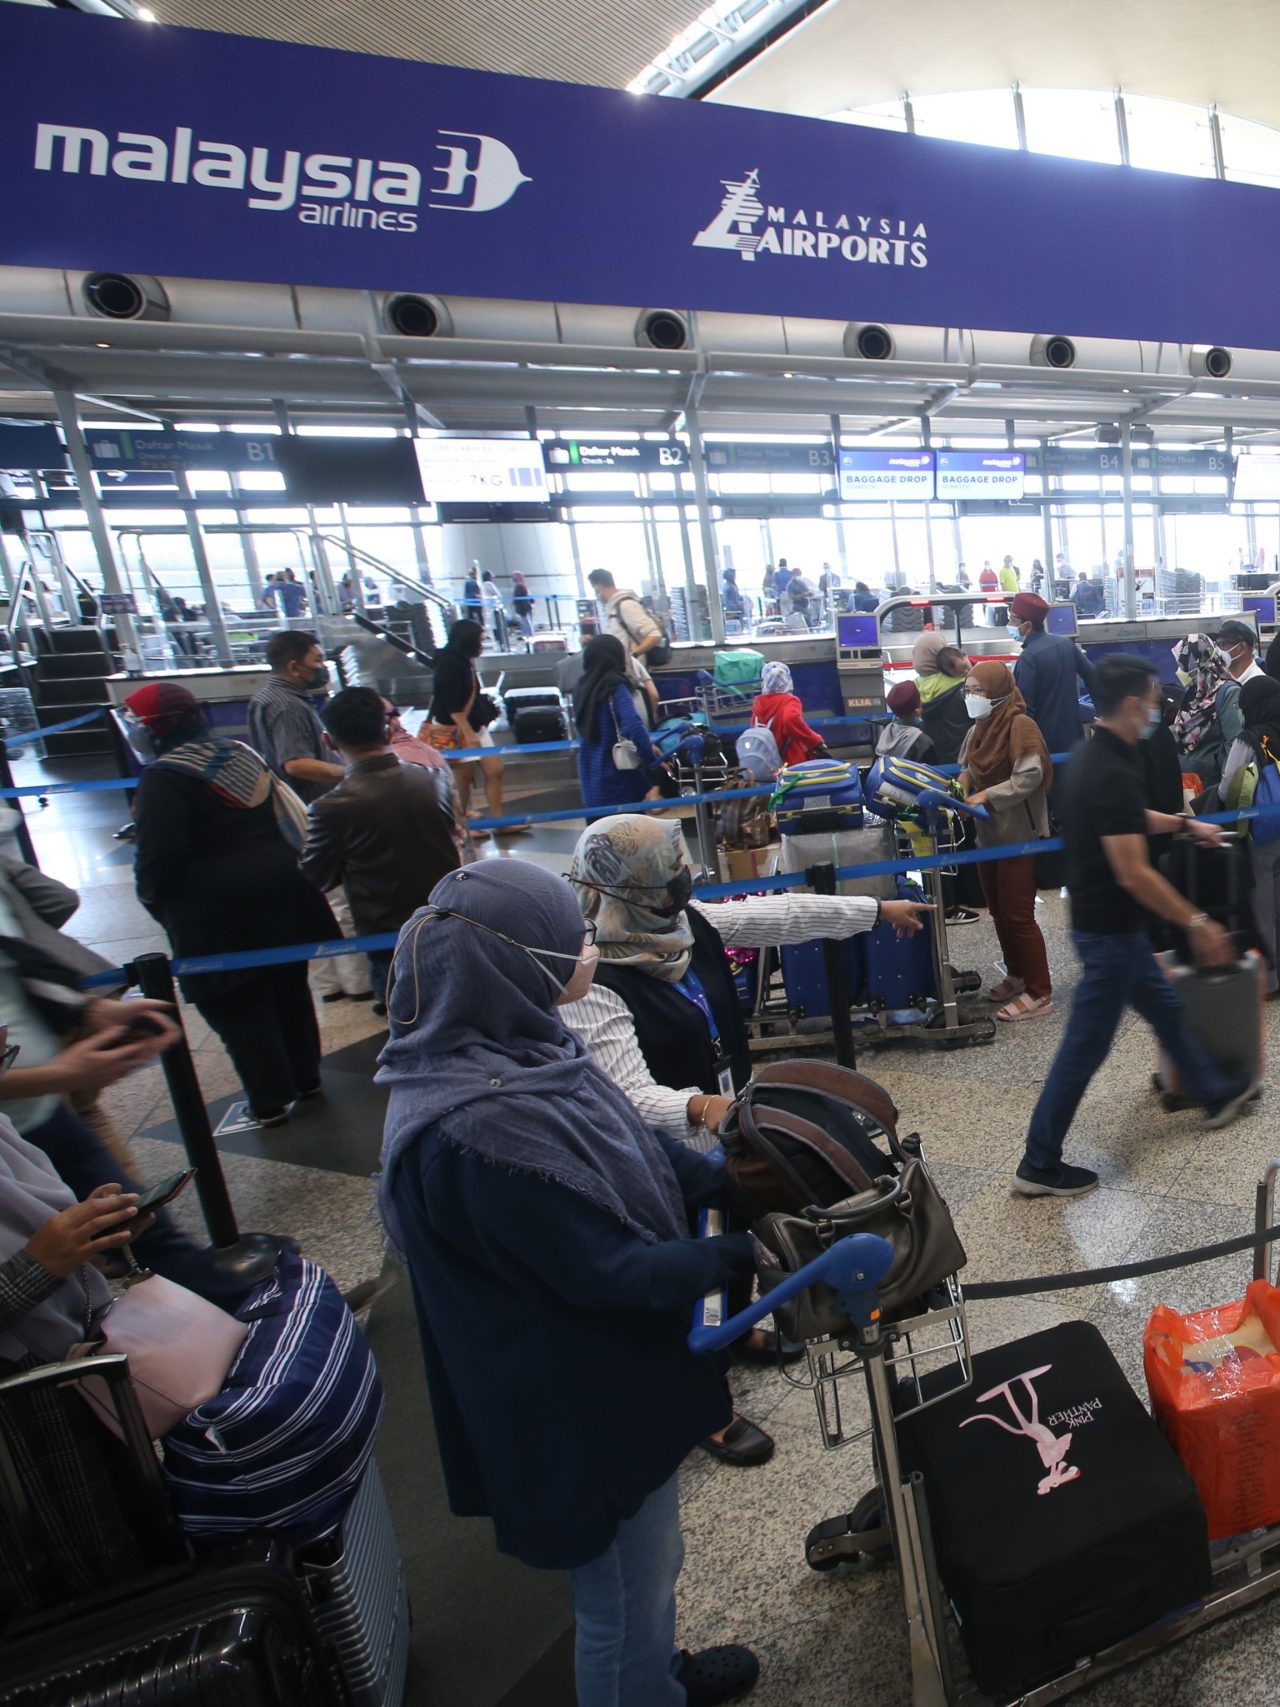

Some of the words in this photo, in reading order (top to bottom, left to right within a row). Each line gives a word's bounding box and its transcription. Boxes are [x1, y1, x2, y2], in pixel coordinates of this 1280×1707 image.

[34, 123, 421, 211] malaysia
[299, 202, 418, 233] airlines
[767, 205, 928, 239] MALAYSIA
[756, 226, 928, 268] AIRPORTS
[245, 441, 275, 461] B1
[658, 447, 684, 466] B2
[808, 450, 831, 467] B3
[1100, 454, 1118, 469] B4
[1208, 456, 1225, 471] B5
[846, 475, 897, 483] BAGGAGE
[899, 475, 928, 483] DROP
[848, 698, 872, 707] KLIA
[1047, 1397, 1103, 1426] PANTHER
[1065, 1411, 1095, 1429] PINK
